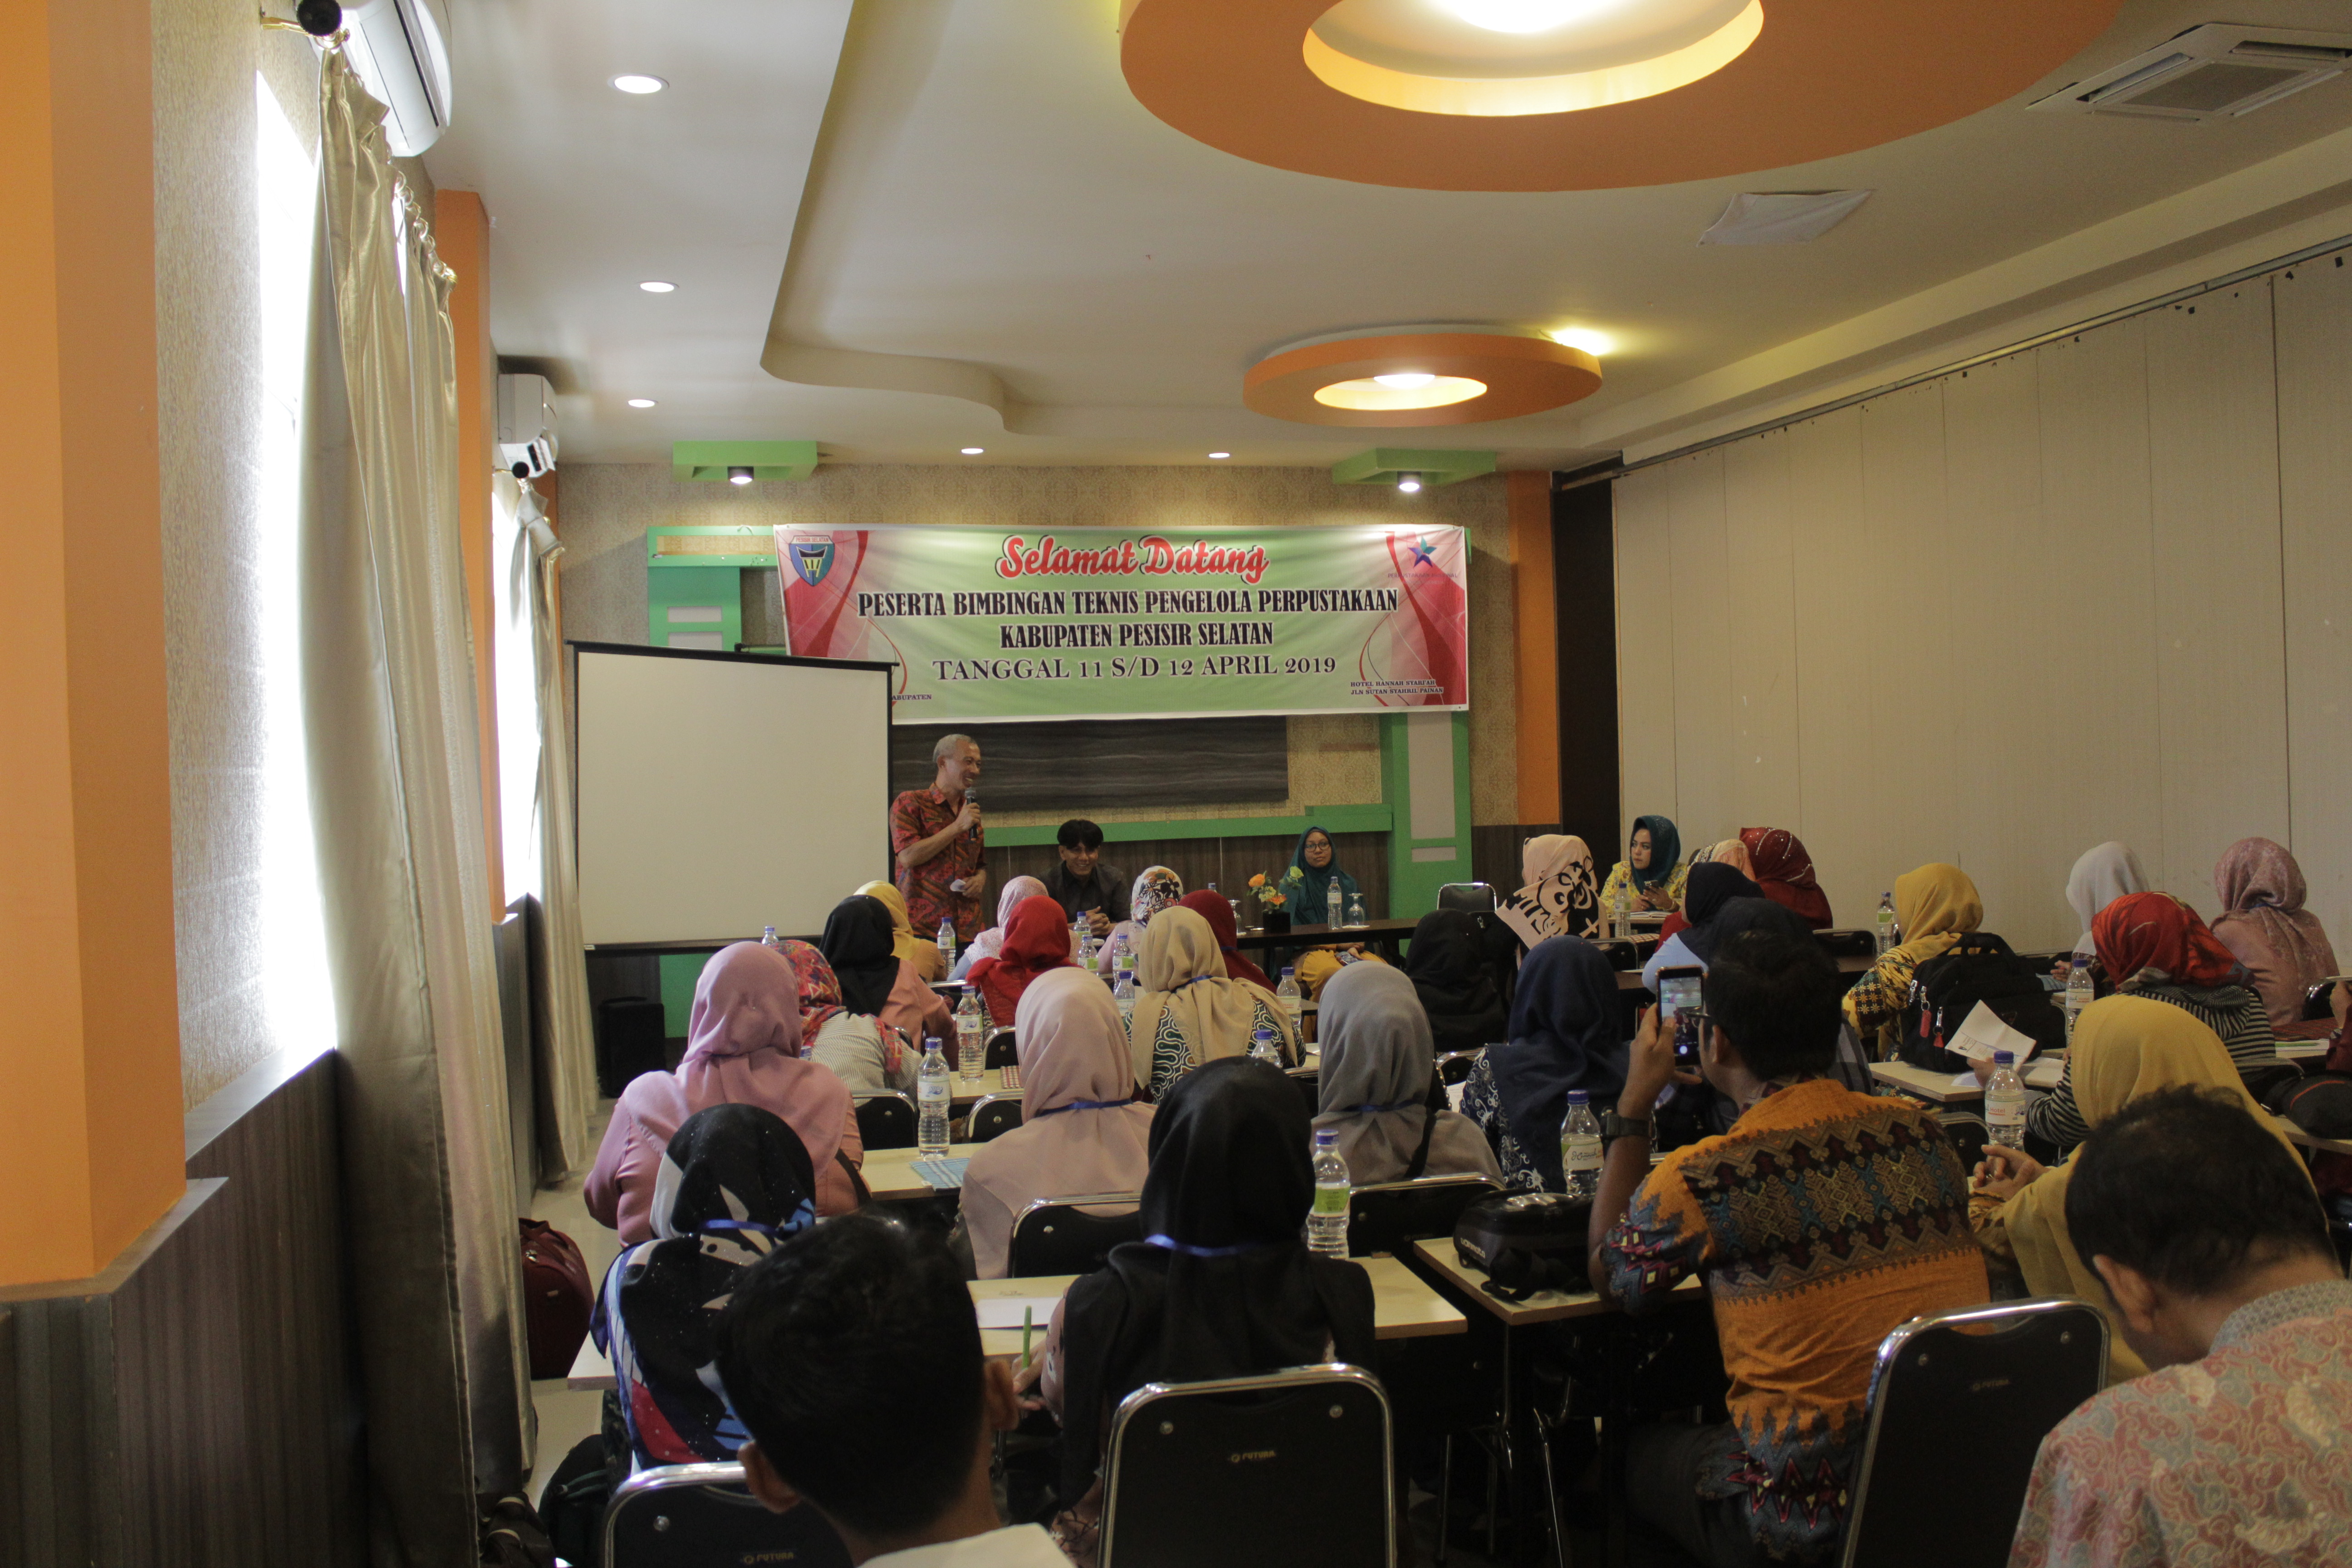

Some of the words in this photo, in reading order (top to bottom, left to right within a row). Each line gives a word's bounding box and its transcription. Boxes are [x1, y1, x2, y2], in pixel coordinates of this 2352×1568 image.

[996, 535, 1139, 578] Selamat
[1139, 535, 1269, 585] Datang
[858, 593, 946, 617] PESERTA
[953, 591, 1065, 615] BIMBINGAN
[1072, 591, 1138, 614] TEKNIS
[1145, 590, 1252, 613] PENGELOLA
[1258, 590, 1398, 612] PERPUSTAKAAN
[1000, 624, 1112, 648] KABUPATEN
[1119, 623, 1192, 646] PESISIR
[1199, 622, 1273, 645] SELATAN
[932, 659, 1070, 680] TANGGAL
[1079, 661, 1102, 678] 11
[1111, 656, 1159, 677] S/D
[1169, 659, 1194, 676] 12
[1201, 655, 1278, 675] APRIL
[1285, 657, 1336, 674] 2019
[1242, 1450, 1276, 1460] FUTURA
[757, 1552, 794, 1562] FUTURA
